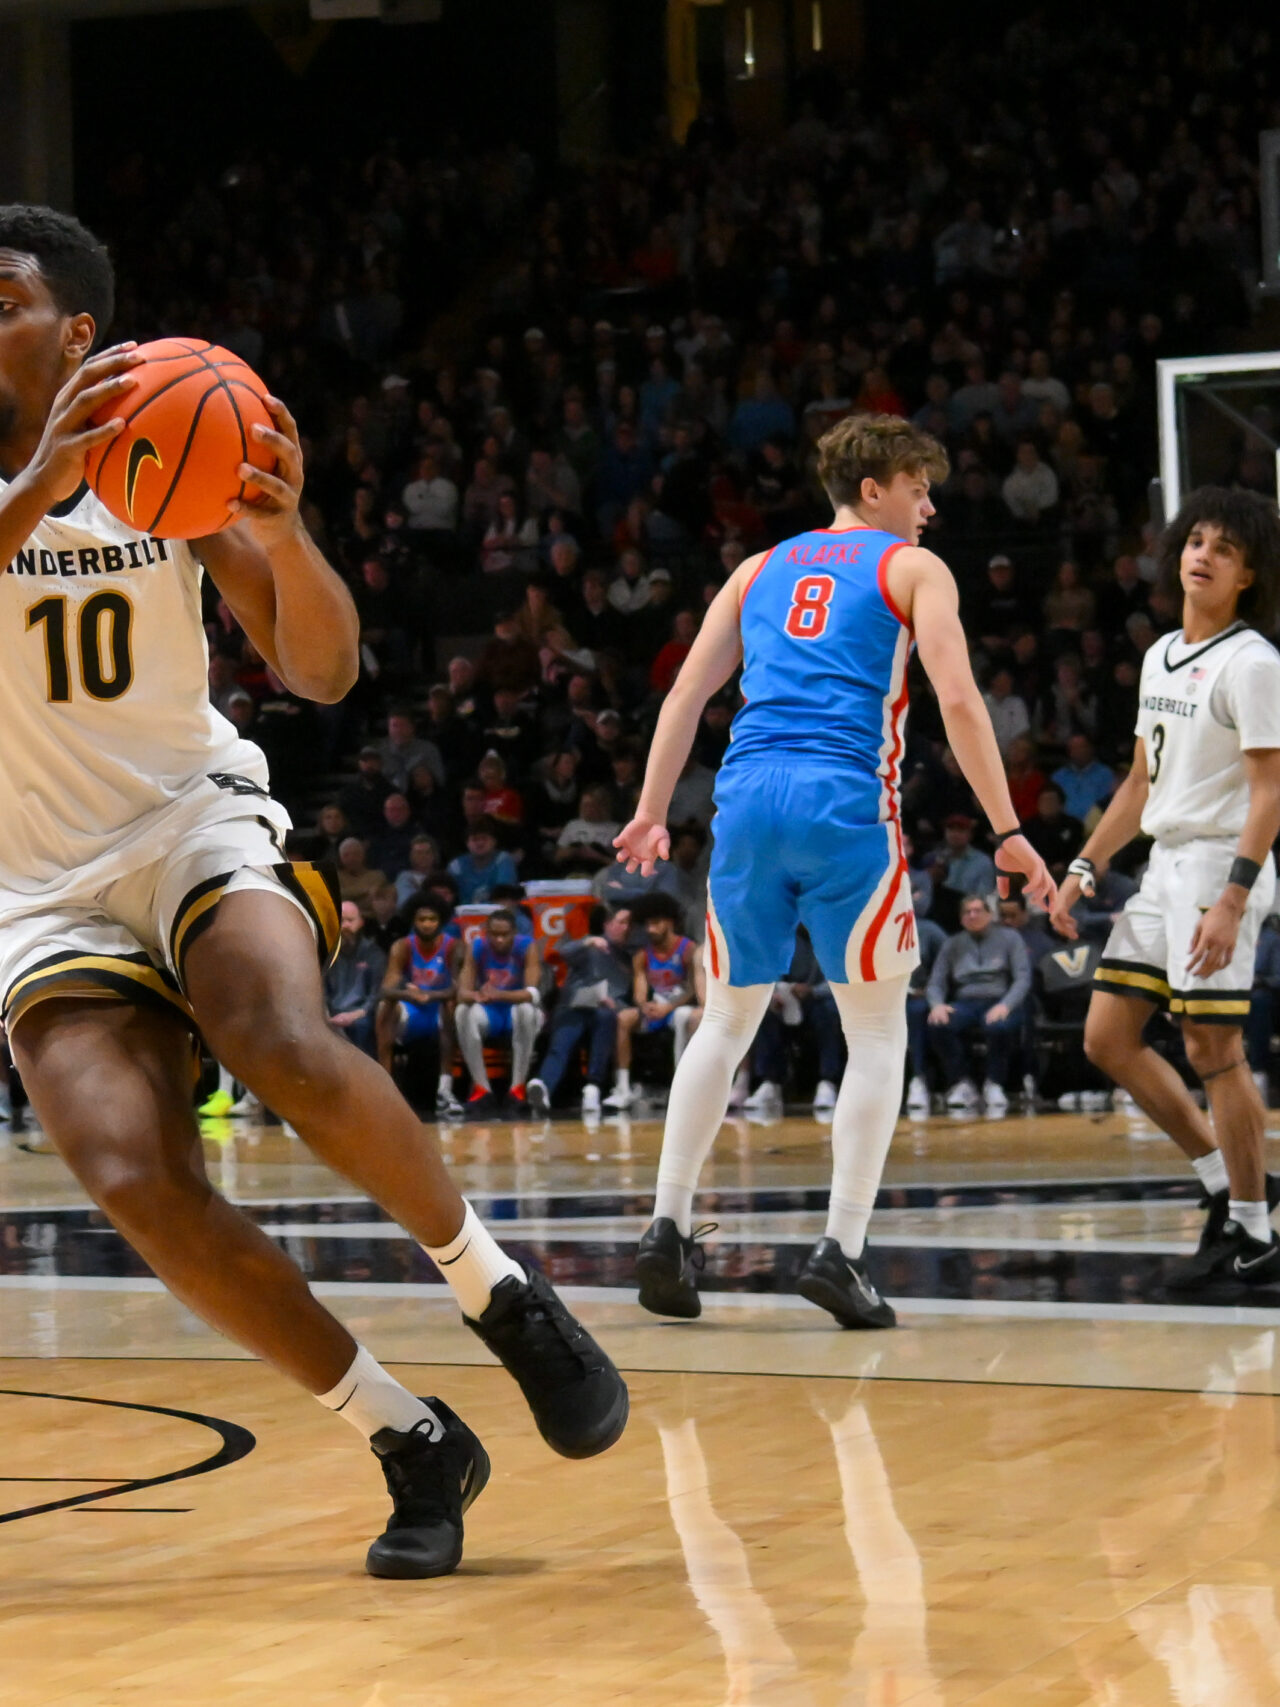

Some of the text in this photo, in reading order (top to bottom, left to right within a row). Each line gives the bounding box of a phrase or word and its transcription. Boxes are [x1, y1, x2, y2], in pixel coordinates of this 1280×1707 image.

[7, 537, 168, 576] NDERBILT
[784, 543, 867, 565] KLAFKE
[784, 574, 836, 640] 8
[24, 588, 135, 704] 10
[1149, 721, 1166, 785] 3
[540, 907, 567, 936] G
[1051, 945, 1091, 978] V
